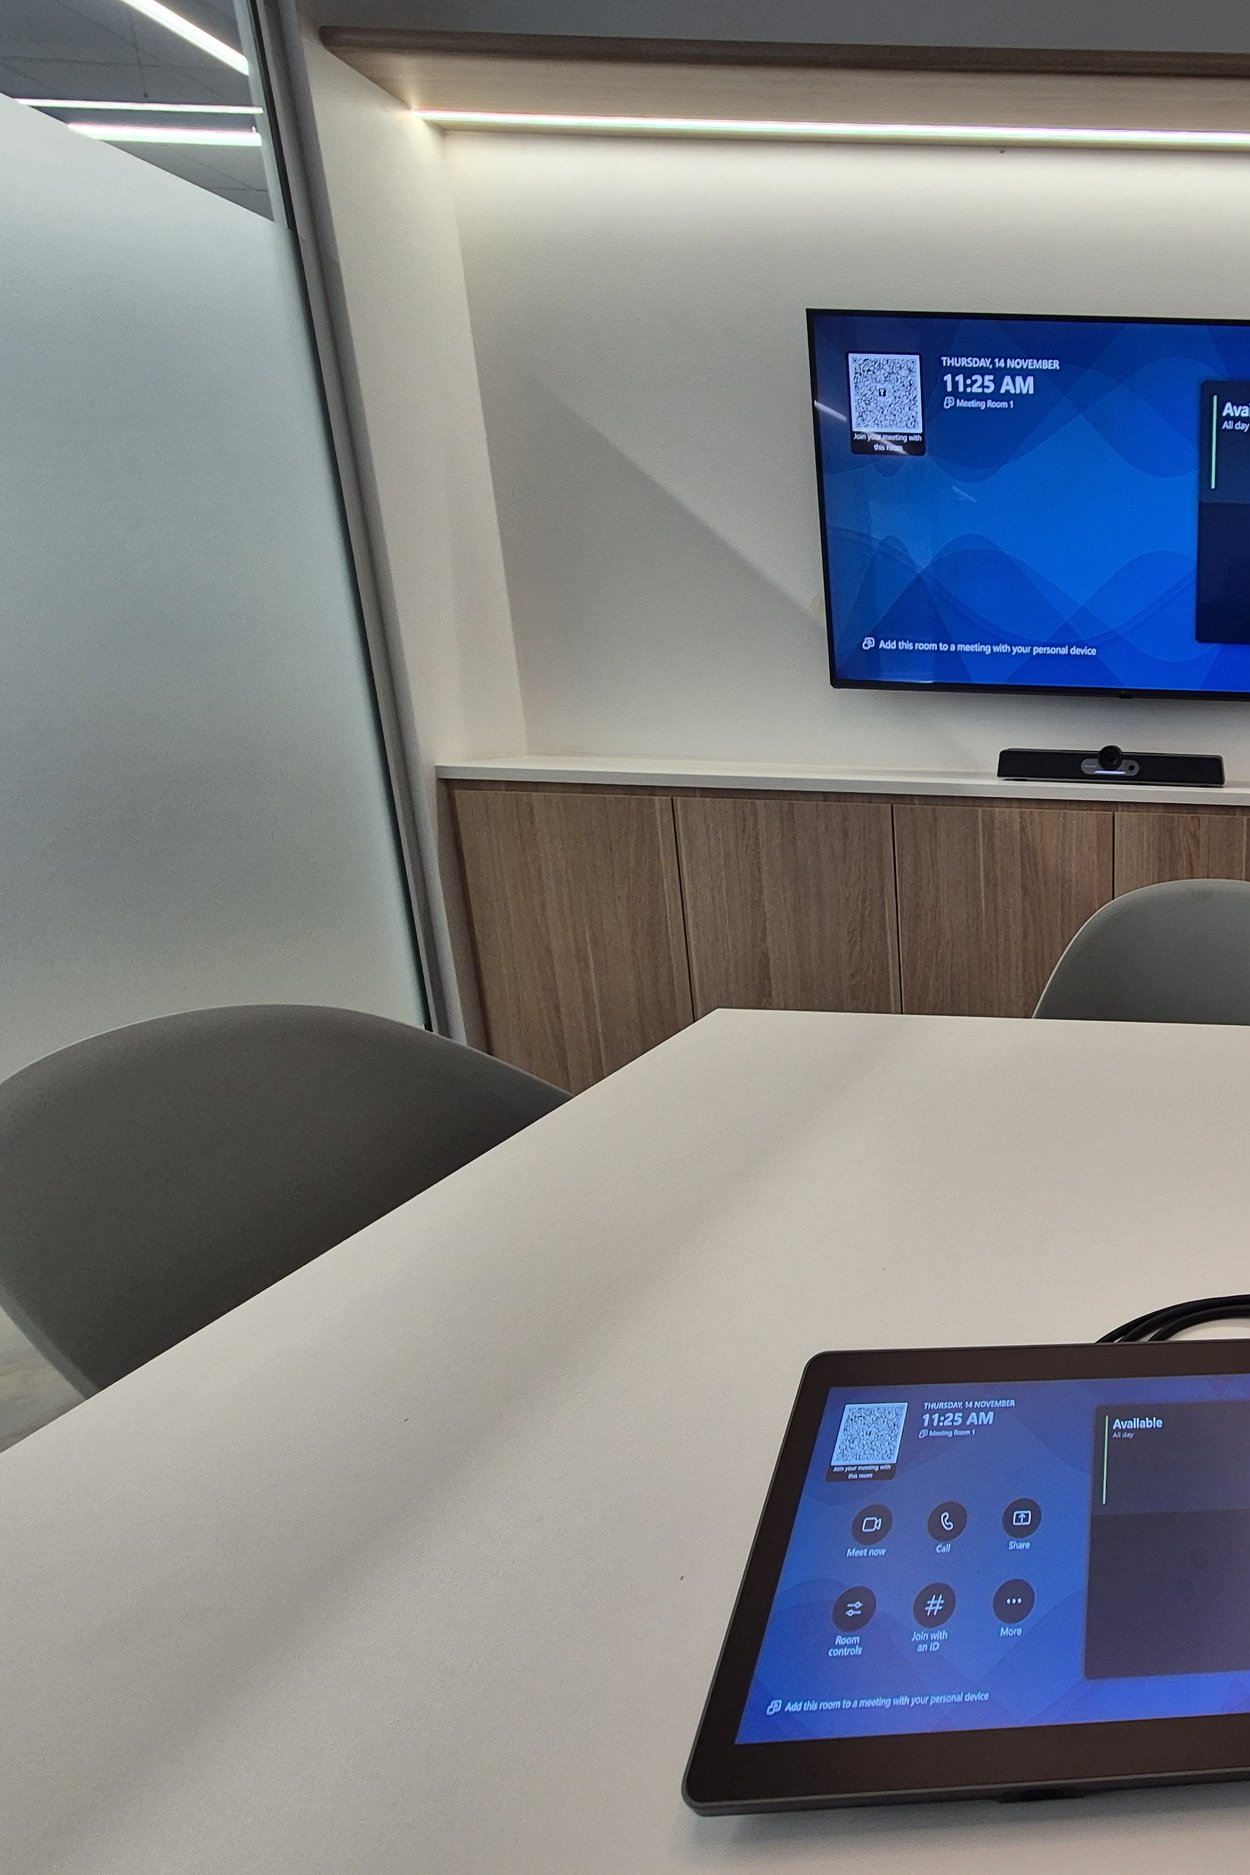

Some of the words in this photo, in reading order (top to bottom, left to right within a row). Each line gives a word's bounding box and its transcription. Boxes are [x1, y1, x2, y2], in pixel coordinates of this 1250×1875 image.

[941, 357, 992, 368] THURSDAY,
[994, 358, 1005, 368] 14
[1007, 359, 1060, 369] NOVEMBER
[944, 374, 994, 393] 11:25
[1000, 376, 1034, 394] AM
[957, 399, 985, 410] Meeting
[987, 399, 1008, 408] Room
[1222, 421, 1233, 429] All
[1235, 421, 1250, 432] day
[883, 435, 907, 443] meeting
[879, 640, 896, 649] Add
[898, 641, 913, 650] this
[939, 642, 948, 651] to
[957, 643, 991, 654] meeting
[993, 644, 1010, 652] with
[1012, 646, 1031, 655] your
[1033, 645, 1068, 655] personal
[1070, 646, 1096, 655] device
[924, 1401, 963, 1409] THURSDAY,
[974, 1400, 1015, 1408] NOVEMBER
[922, 1413, 962, 1427] 11:25
[966, 1412, 993, 1425] AM
[1113, 1417, 1162, 1429] Available
[936, 1544, 951, 1553] Call
[1009, 1541, 1030, 1550] Share
[847, 1548, 867, 1557] Meet
[912, 1632, 929, 1642] Join
[930, 1631, 948, 1640] with
[1000, 1627, 1022, 1637] More
[835, 1636, 860, 1644] Room
[828, 1646, 862, 1657] controls
[917, 1644, 928, 1652] an
[929, 1643, 939, 1651] ID
[785, 1701, 802, 1712] Add
[804, 1701, 818, 1711] this
[819, 1700, 840, 1710] room
[843, 1699, 850, 1709] to
[859, 1697, 891, 1708] meeting
[893, 1695, 909, 1705] with
[911, 1697, 929, 1707] your
[930, 1692, 963, 1706] personal
[965, 1692, 989, 1701] device
